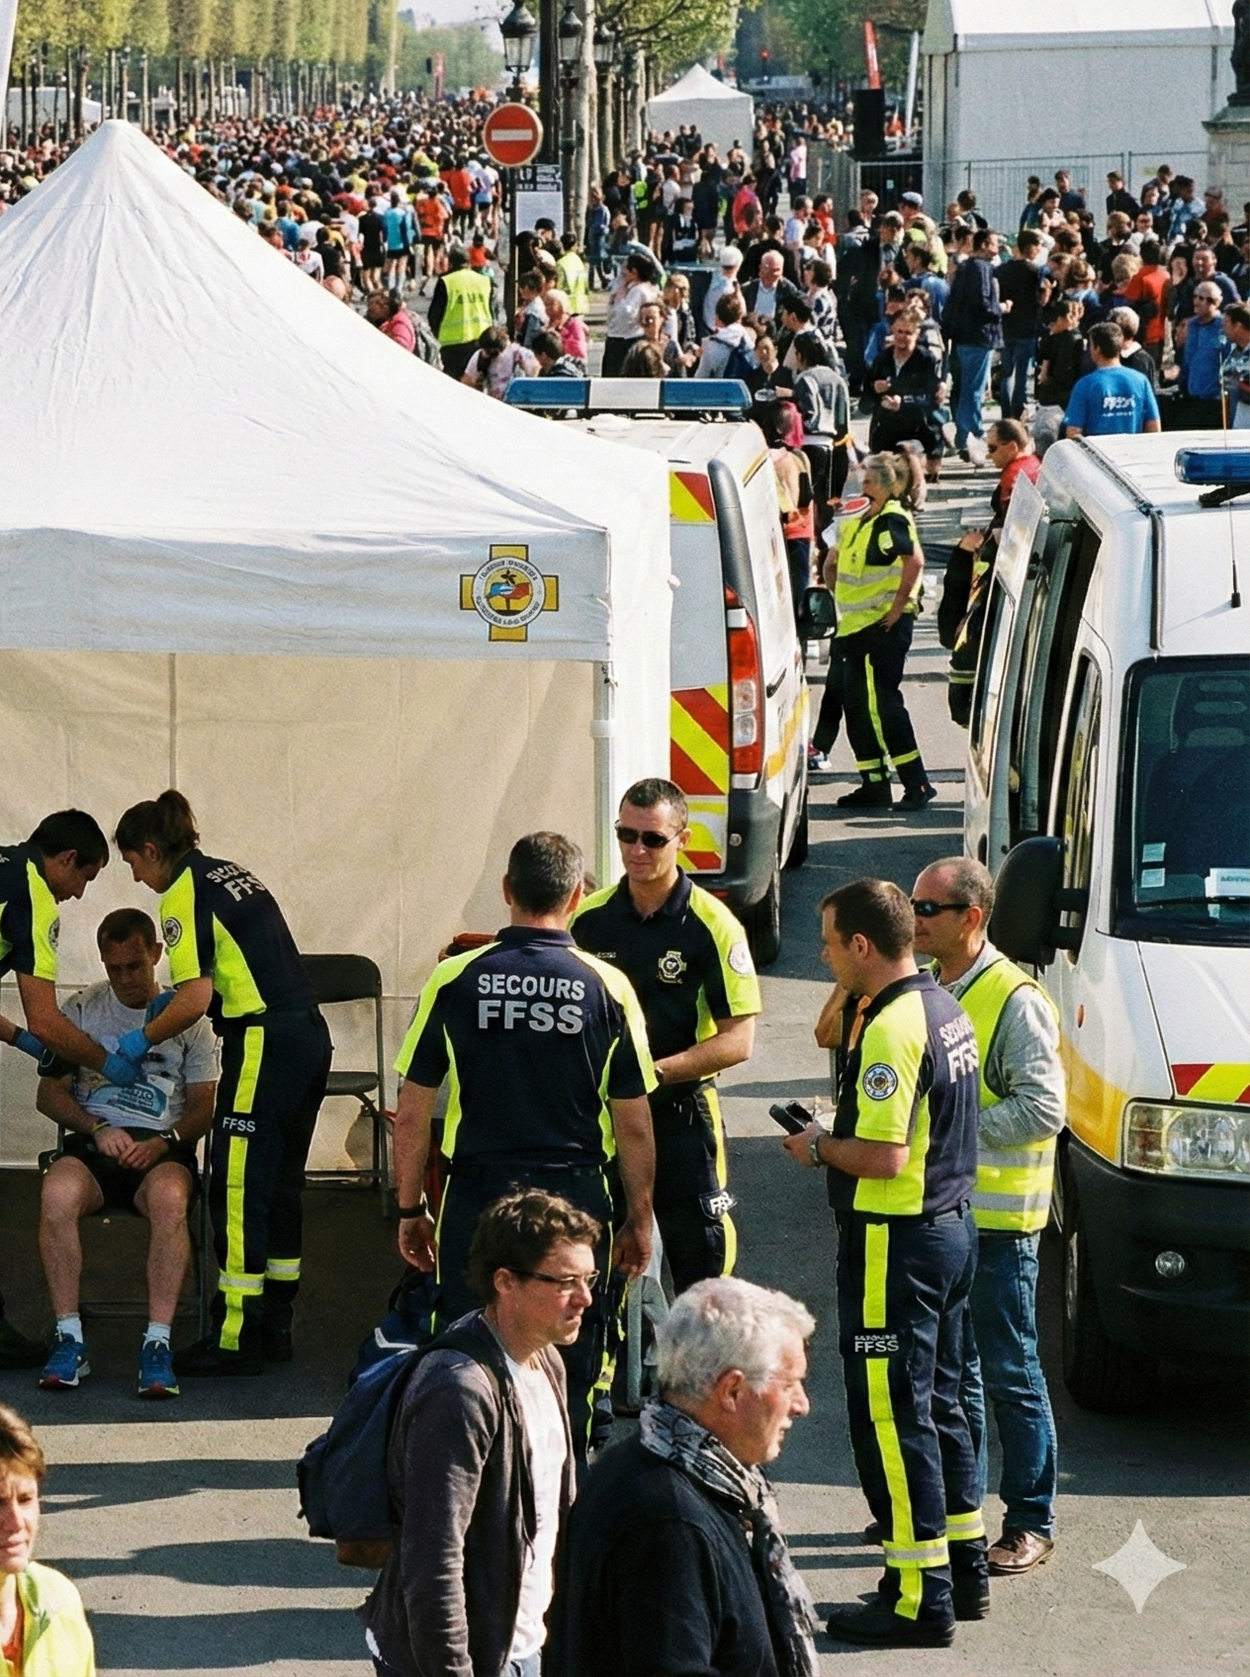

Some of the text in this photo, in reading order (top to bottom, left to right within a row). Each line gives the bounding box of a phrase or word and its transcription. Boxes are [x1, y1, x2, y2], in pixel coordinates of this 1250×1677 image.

[223, 875, 266, 902] FFS
[477, 973, 586, 1001] SECOURS
[478, 999, 584, 1034] FFSS
[222, 1116, 256, 1133] FFSS
[854, 1340, 900, 1353] FFSS
